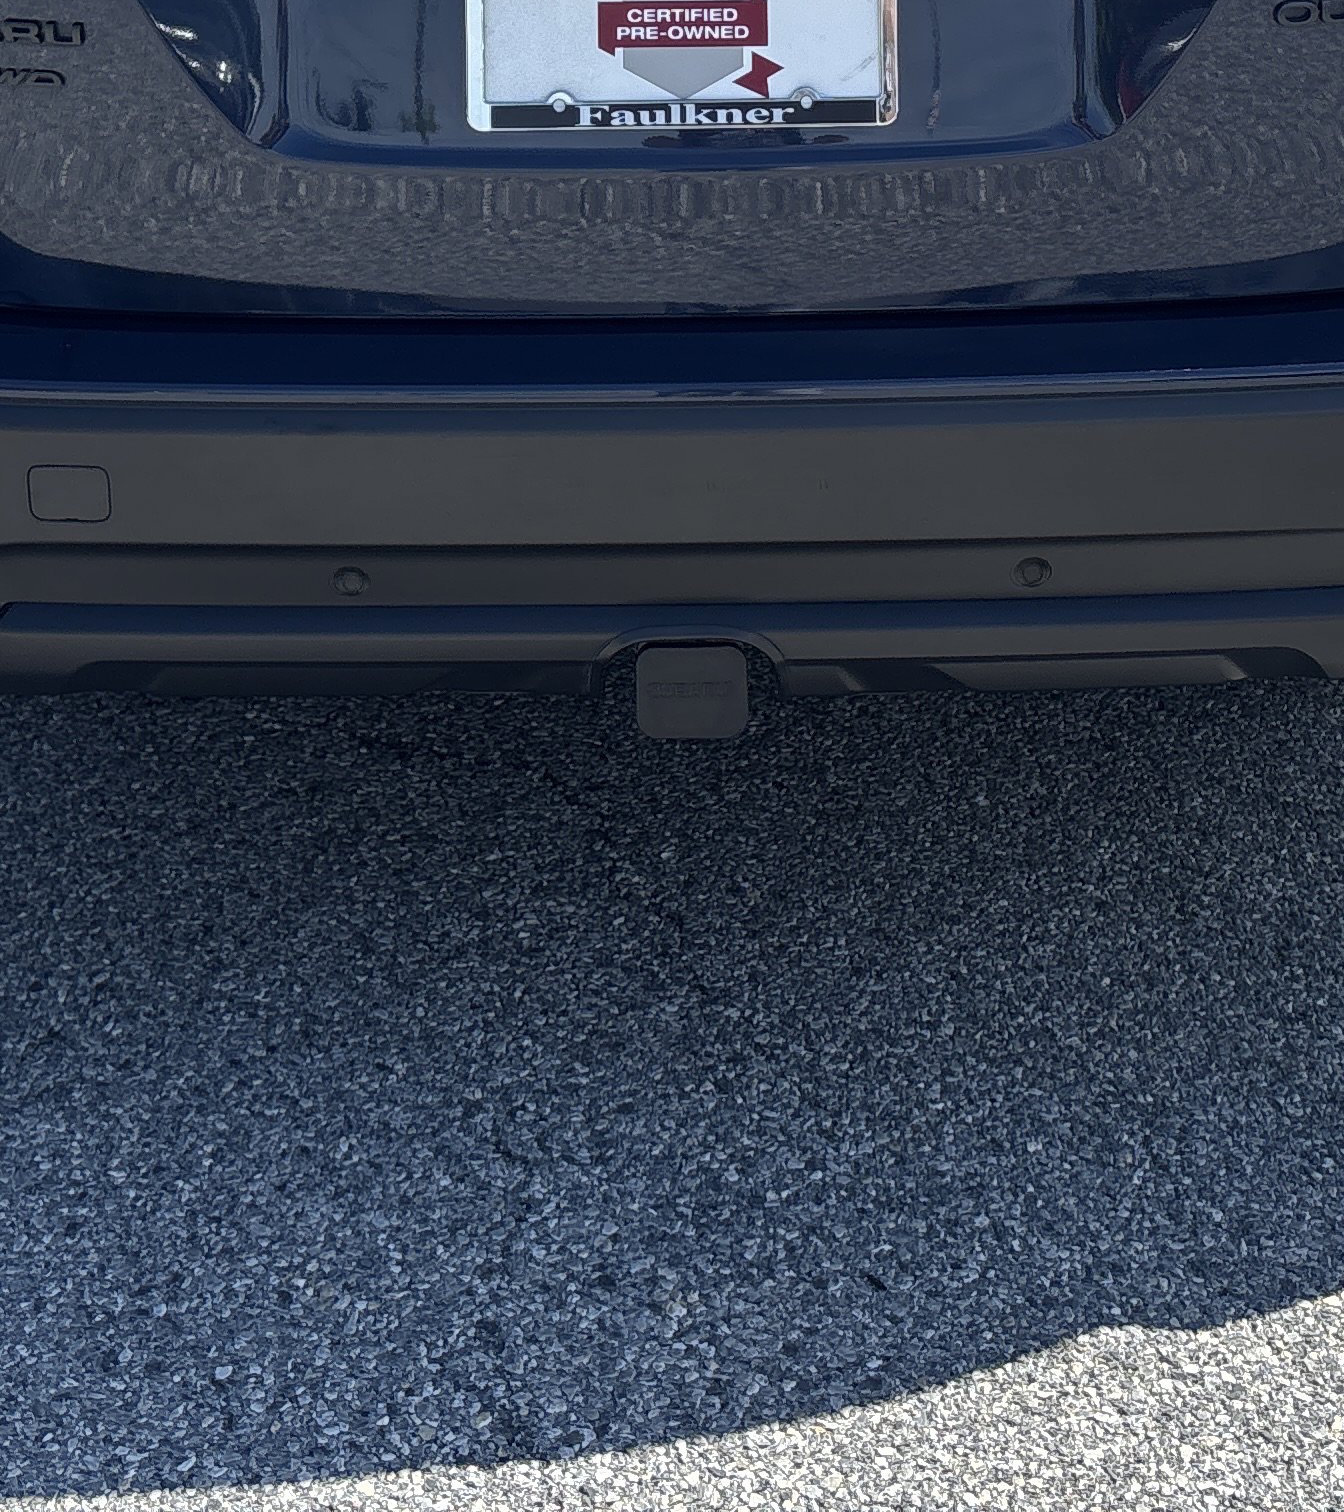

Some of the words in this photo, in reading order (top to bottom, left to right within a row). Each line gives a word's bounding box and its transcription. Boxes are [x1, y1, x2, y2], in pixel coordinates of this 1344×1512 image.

[627, 8, 738, 23] CERTIFIED
[616, 25, 749, 41] PRE-OWNED
[574, 103, 795, 127] Faulkner
